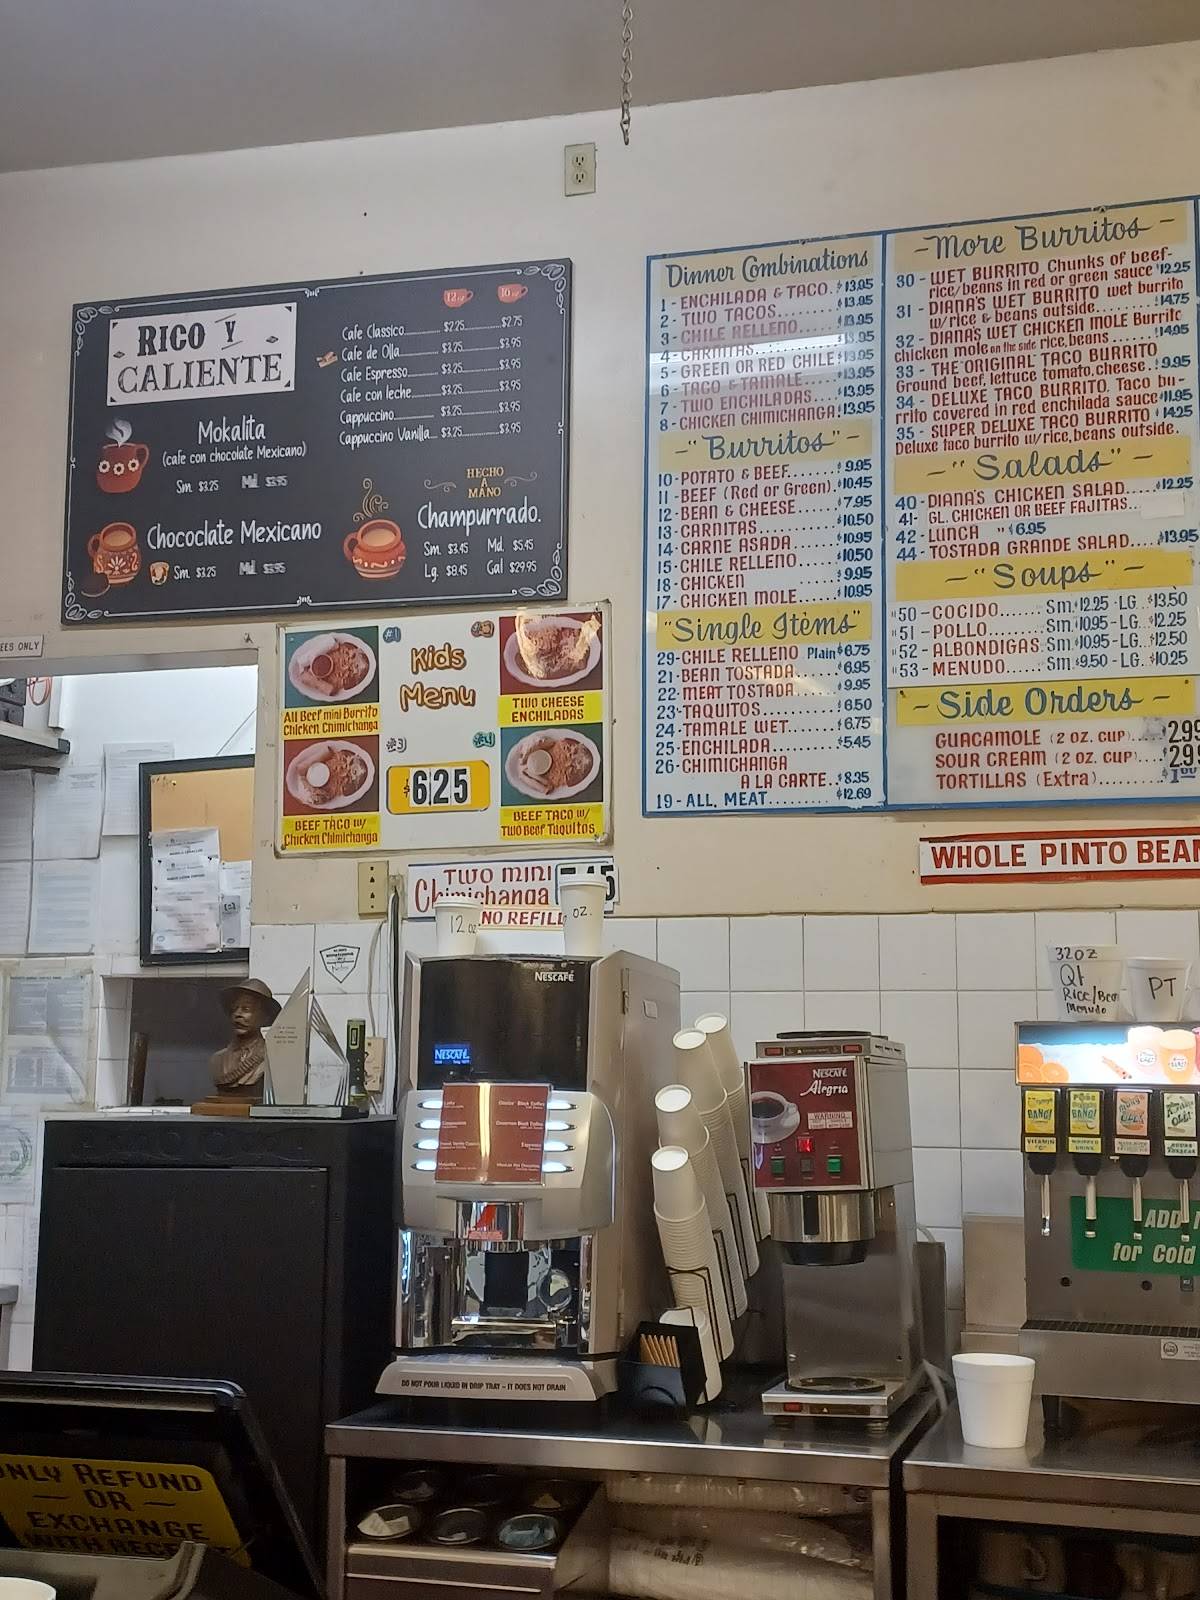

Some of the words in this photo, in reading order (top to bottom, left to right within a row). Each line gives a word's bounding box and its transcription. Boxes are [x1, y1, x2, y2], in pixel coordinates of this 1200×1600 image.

[922, 232, 1006, 260] More
[1014, 217, 1153, 252] Burritos
[666, 264, 736, 288] Dinner
[742, 248, 869, 282] Combinations
[930, 267, 967, 286] WET
[972, 261, 1040, 282] BURRITO
[1047, 253, 1104, 274] Chunks
[1068, 270, 1108, 288] green
[1114, 266, 1153, 279] sauce
[680, 287, 767, 310] ENCHILADA
[928, 295, 986, 315] DIANA'S
[992, 292, 1025, 310] WET
[1032, 284, 1100, 306] BURRITO
[1106, 283, 1133, 299] wet
[1138, 277, 1184, 295] burrito
[681, 310, 717, 327] TWO
[725, 304, 776, 322] TACOS
[994, 305, 1038, 323] beans
[1023, 317, 1085, 337] CHICKEN
[1089, 310, 1129, 329] MOLE
[137, 322, 206, 356] RICO
[225, 321, 236, 342] Y
[342, 326, 363, 341] Cafe
[366, 323, 405, 338] Classico
[341, 348, 363, 362] Cafe
[366, 346, 378, 360] de
[381, 343, 400, 359] Olla
[894, 345, 950, 364] chicken
[953, 341, 989, 358] mole
[1040, 348, 1083, 367] TACO
[1088, 342, 1158, 360] BURRITO
[117, 353, 282, 393] CALIENTE
[341, 368, 362, 383] Cafe
[365, 365, 408, 385] Espresso
[680, 361, 730, 379] GREEN
[735, 358, 754, 375] OR
[758, 356, 785, 372] RED
[792, 351, 834, 369] CHILE
[895, 377, 948, 396] Ground
[990, 369, 1038, 387] lettuce
[931, 389, 988, 408] DELUXE
[993, 383, 1033, 402] TACO
[1115, 375, 1151, 392] Taco
[340, 389, 362, 404] Cafe
[365, 390, 383, 401] con
[385, 384, 412, 400] leche
[720, 389, 812, 411] ENCHILADAS
[679, 412, 736, 432] CHICKEN
[740, 404, 836, 427] CHIMICHANGA
[932, 402, 990, 423] covered
[1012, 401, 1036, 416] red
[1041, 393, 1110, 415] enchilada
[1115, 392, 1159, 407] sauce
[198, 414, 266, 445] Mokalita
[340, 409, 394, 429] Cappuccino
[930, 421, 977, 441] SUPER
[981, 416, 1035, 435] DELUXE
[1039, 411, 1080, 430] TACO
[1084, 406, 1152, 425] BURRITO
[339, 430, 393, 450] Cappuccino
[397, 425, 430, 442] Vanilla
[895, 437, 939, 455] Deluxe
[943, 436, 970, 451] taco
[973, 432, 1020, 450] burrito
[189, 450, 207, 464] con
[210, 446, 254, 462] chocolate
[256, 441, 307, 460] Mexicano)
[466, 467, 504, 479] HECHO
[680, 467, 735, 486] POTATO
[753, 464, 790, 481] BEEF
[468, 487, 501, 499] MANO
[928, 488, 986, 508] DIANA'S
[995, 484, 1066, 504] CHICKEN
[1073, 481, 1125, 498] SALAD
[417, 496, 542, 536] Champurrado.
[680, 504, 718, 522] BEAN
[739, 499, 796, 518] CHEESE
[951, 504, 1010, 522] CHICKEN
[1014, 503, 1031, 518] OR
[1035, 501, 1066, 516] BEEF
[1070, 497, 1128, 514] FAJITAS
[147, 519, 234, 551] Chococlate
[240, 520, 322, 545] Mexicano
[680, 520, 757, 539] CARNITAS
[928, 525, 980, 543] LUNCH
[680, 538, 732, 556] CARNE
[739, 535, 791, 552] ASADA
[929, 540, 1000, 560] TOSTADA
[1007, 536, 1073, 554] GRANDE
[1078, 533, 1130, 550] SALAD
[486, 558, 504, 575] Gal
[680, 592, 748, 609] CHICKEN
[754, 589, 798, 605] MOLE
[932, 602, 999, 621] COCIDO
[933, 622, 987, 639] POLLO
[18, 641, 39, 651] ONLY
[681, 648, 726, 665] CHILE
[731, 645, 799, 663] RELLENO
[807, 647, 836, 660] Plain
[933, 637, 1040, 658] ALBONDIGAS
[411, 642, 467, 674] Kids
[932, 659, 1005, 677] MENUDO
[681, 667, 720, 683] BEAN
[726, 664, 794, 681] TOSTADA
[400, 681, 476, 712] Menu
[512, 697, 538, 709] TWO
[541, 695, 585, 708] CHEESE
[682, 685, 721, 701] MEAT
[729, 683, 794, 700] TOSTADA
[936, 688, 1014, 720] Side
[1024, 686, 1144, 716] Orders
[511, 708, 584, 723] ENCHILADAS
[682, 702, 761, 719] TAQUITOS
[682, 720, 747, 737] TAMALE
[754, 720, 789, 735] WET
[935, 729, 1041, 749] GUACAMOLE
[682, 755, 788, 774] CHIMICHANGA
[935, 752, 981, 769] SOUR
[986, 750, 1047, 767] CREAM
[778, 771, 826, 788] CARTE
[936, 772, 1027, 790] TORTILLAS
[295, 819, 320, 831] BEEF
[324, 818, 350, 830] TACO
[513, 810, 542, 822] BEEF
[545, 809, 573, 820] TACO
[931, 843, 1027, 869] WHOLE
[1040, 841, 1127, 866] PINTO
[443, 867, 494, 885] TWO
[451, 915, 465, 934] 12
[481, 911, 503, 925] NO
[1149, 976, 1176, 999] PT
[1067, 1003, 1107, 1015] Menudo
[800, 1080, 848, 1096] Alegria
[1113, 1242, 1142, 1262] for
[1152, 1243, 1196, 1265] Cold
[72, 1463, 202, 1492] REFUND
[83, 1489, 135, 1512] OR
[26, 1511, 210, 1541] EXCHANGE
